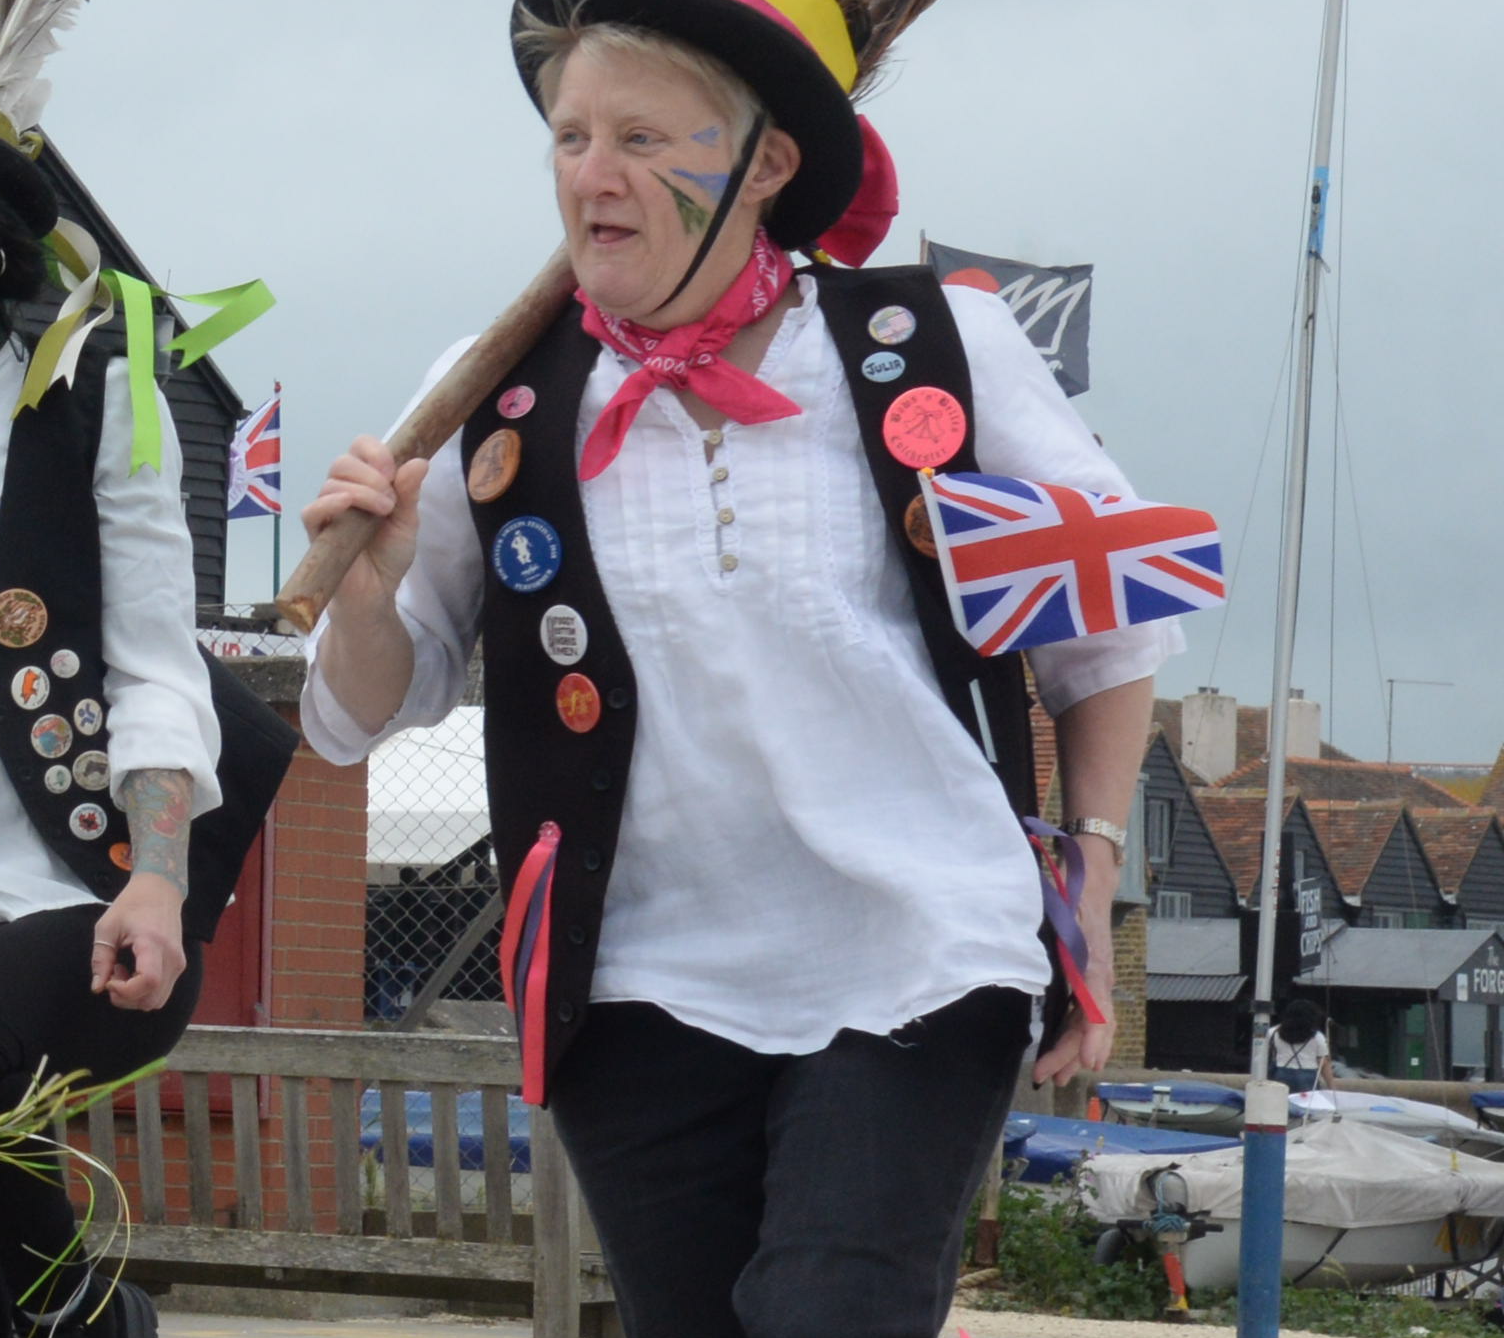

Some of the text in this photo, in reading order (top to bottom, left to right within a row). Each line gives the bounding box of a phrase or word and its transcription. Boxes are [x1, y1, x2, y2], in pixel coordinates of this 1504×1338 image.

[865, 359, 903, 376] JULIA
[1301, 886, 1322, 914] FISH
[1300, 928, 1322, 957] CHIPS
